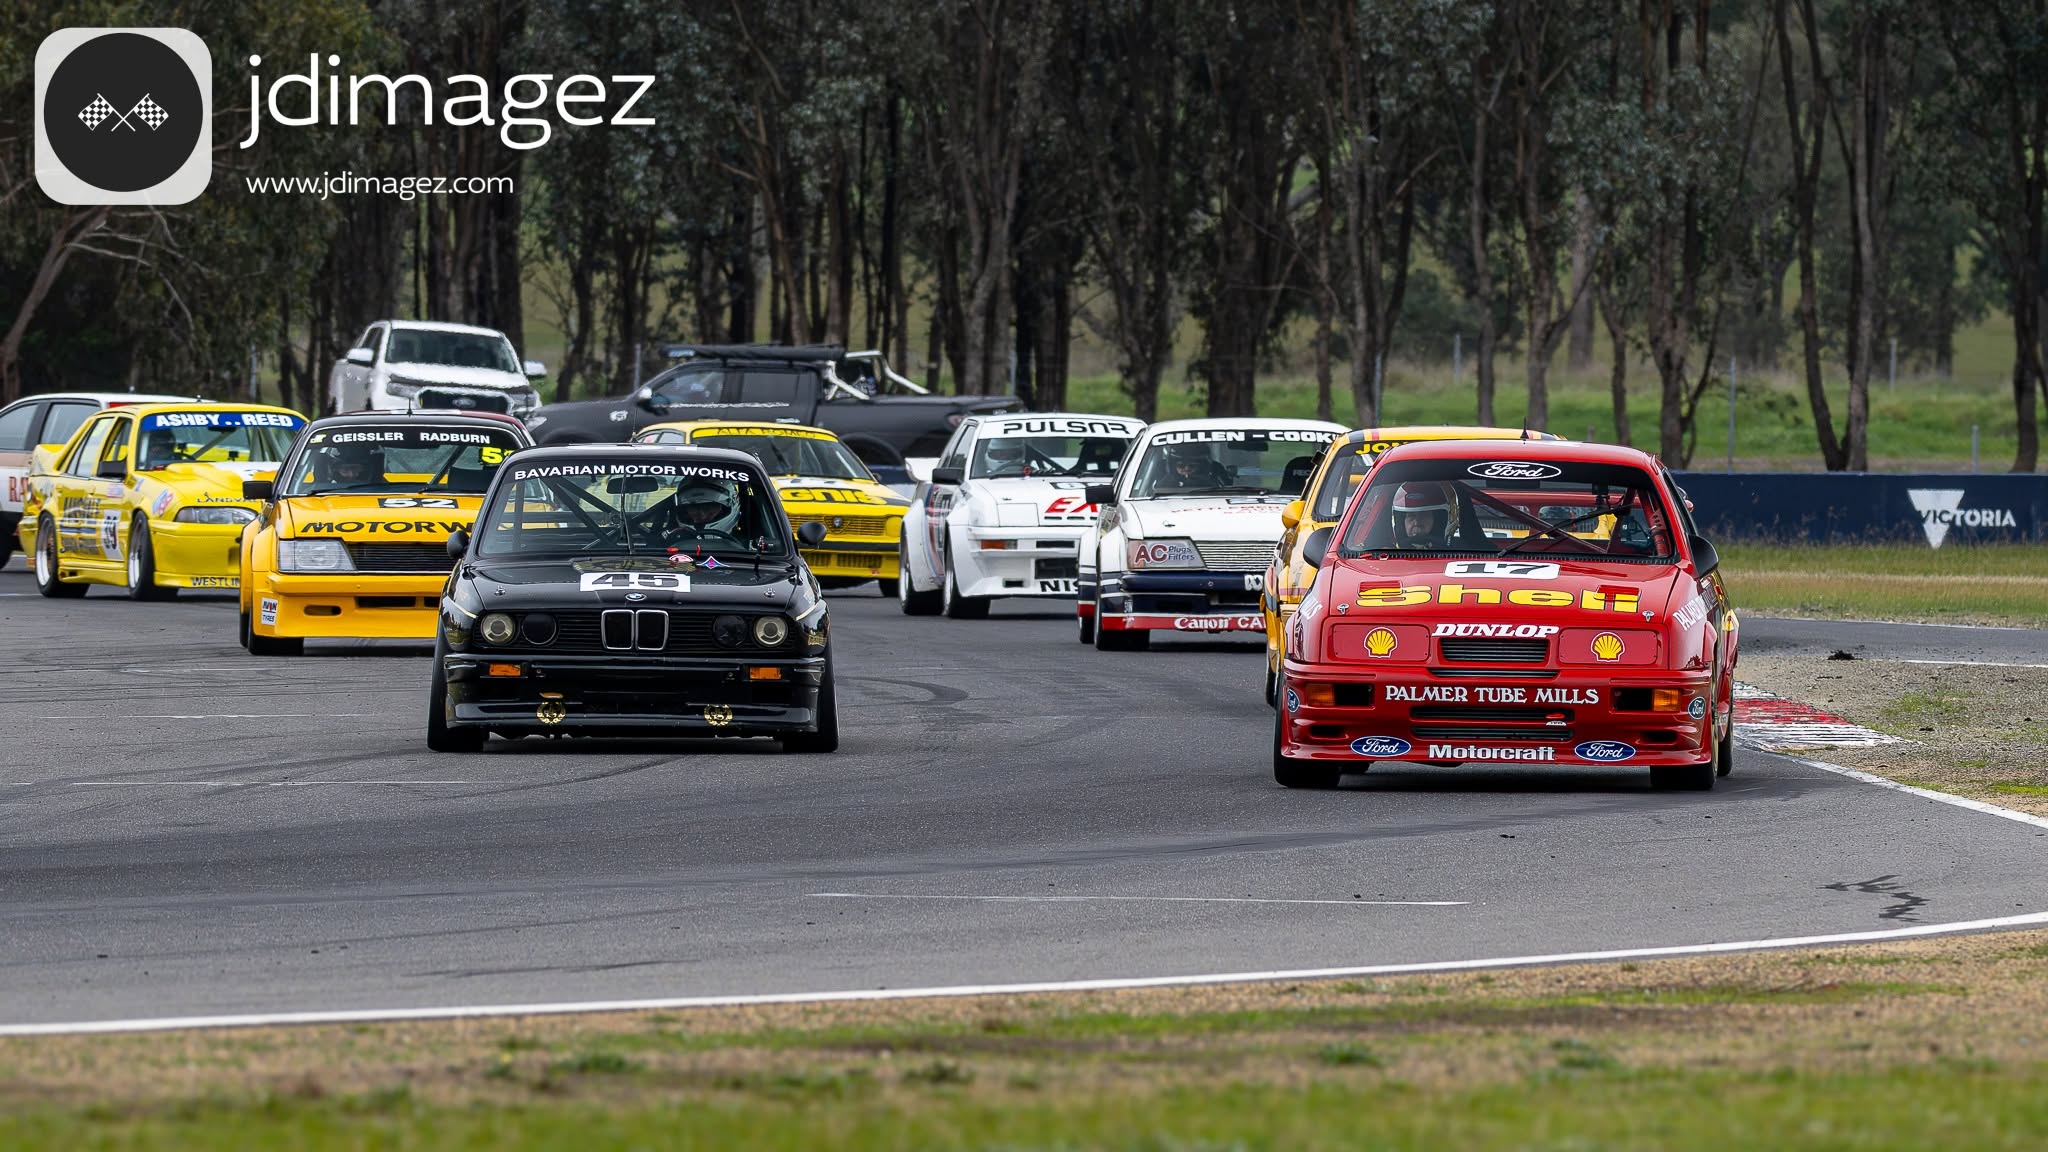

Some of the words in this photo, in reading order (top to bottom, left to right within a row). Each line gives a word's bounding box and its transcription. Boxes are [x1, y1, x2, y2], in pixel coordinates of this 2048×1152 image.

[156, 414, 220, 427] ASHBY
[242, 414, 294, 427] REED
[332, 432, 404, 443] GEISSLER
[420, 432, 491, 444] RADBURN
[1152, 431, 1246, 446] CULLEN
[1269, 431, 1339, 444] COOK
[514, 465, 606, 480] BAVARIAN
[611, 465, 677, 476] MOTOR
[681, 466, 750, 482] WORKS
[1485, 463, 1544, 478] Ford
[383, 498, 456, 508] 52
[1921, 509, 2017, 527] VICTORIA
[1134, 544, 1169, 565] AC
[1454, 562, 1550, 575] 17
[592, 573, 679, 587] 45
[1174, 617, 1230, 629] Canon
[1237, 617, 1266, 629] CA
[1431, 623, 1560, 638] DUNLOP
[1385, 685, 1468, 702] PALMER
[1473, 687, 1528, 704] TUBE
[1534, 688, 1600, 704] MILLS
[1361, 738, 1399, 754] Ford
[1429, 744, 1556, 761] Motorcraft
[1585, 743, 1623, 759] Ford
